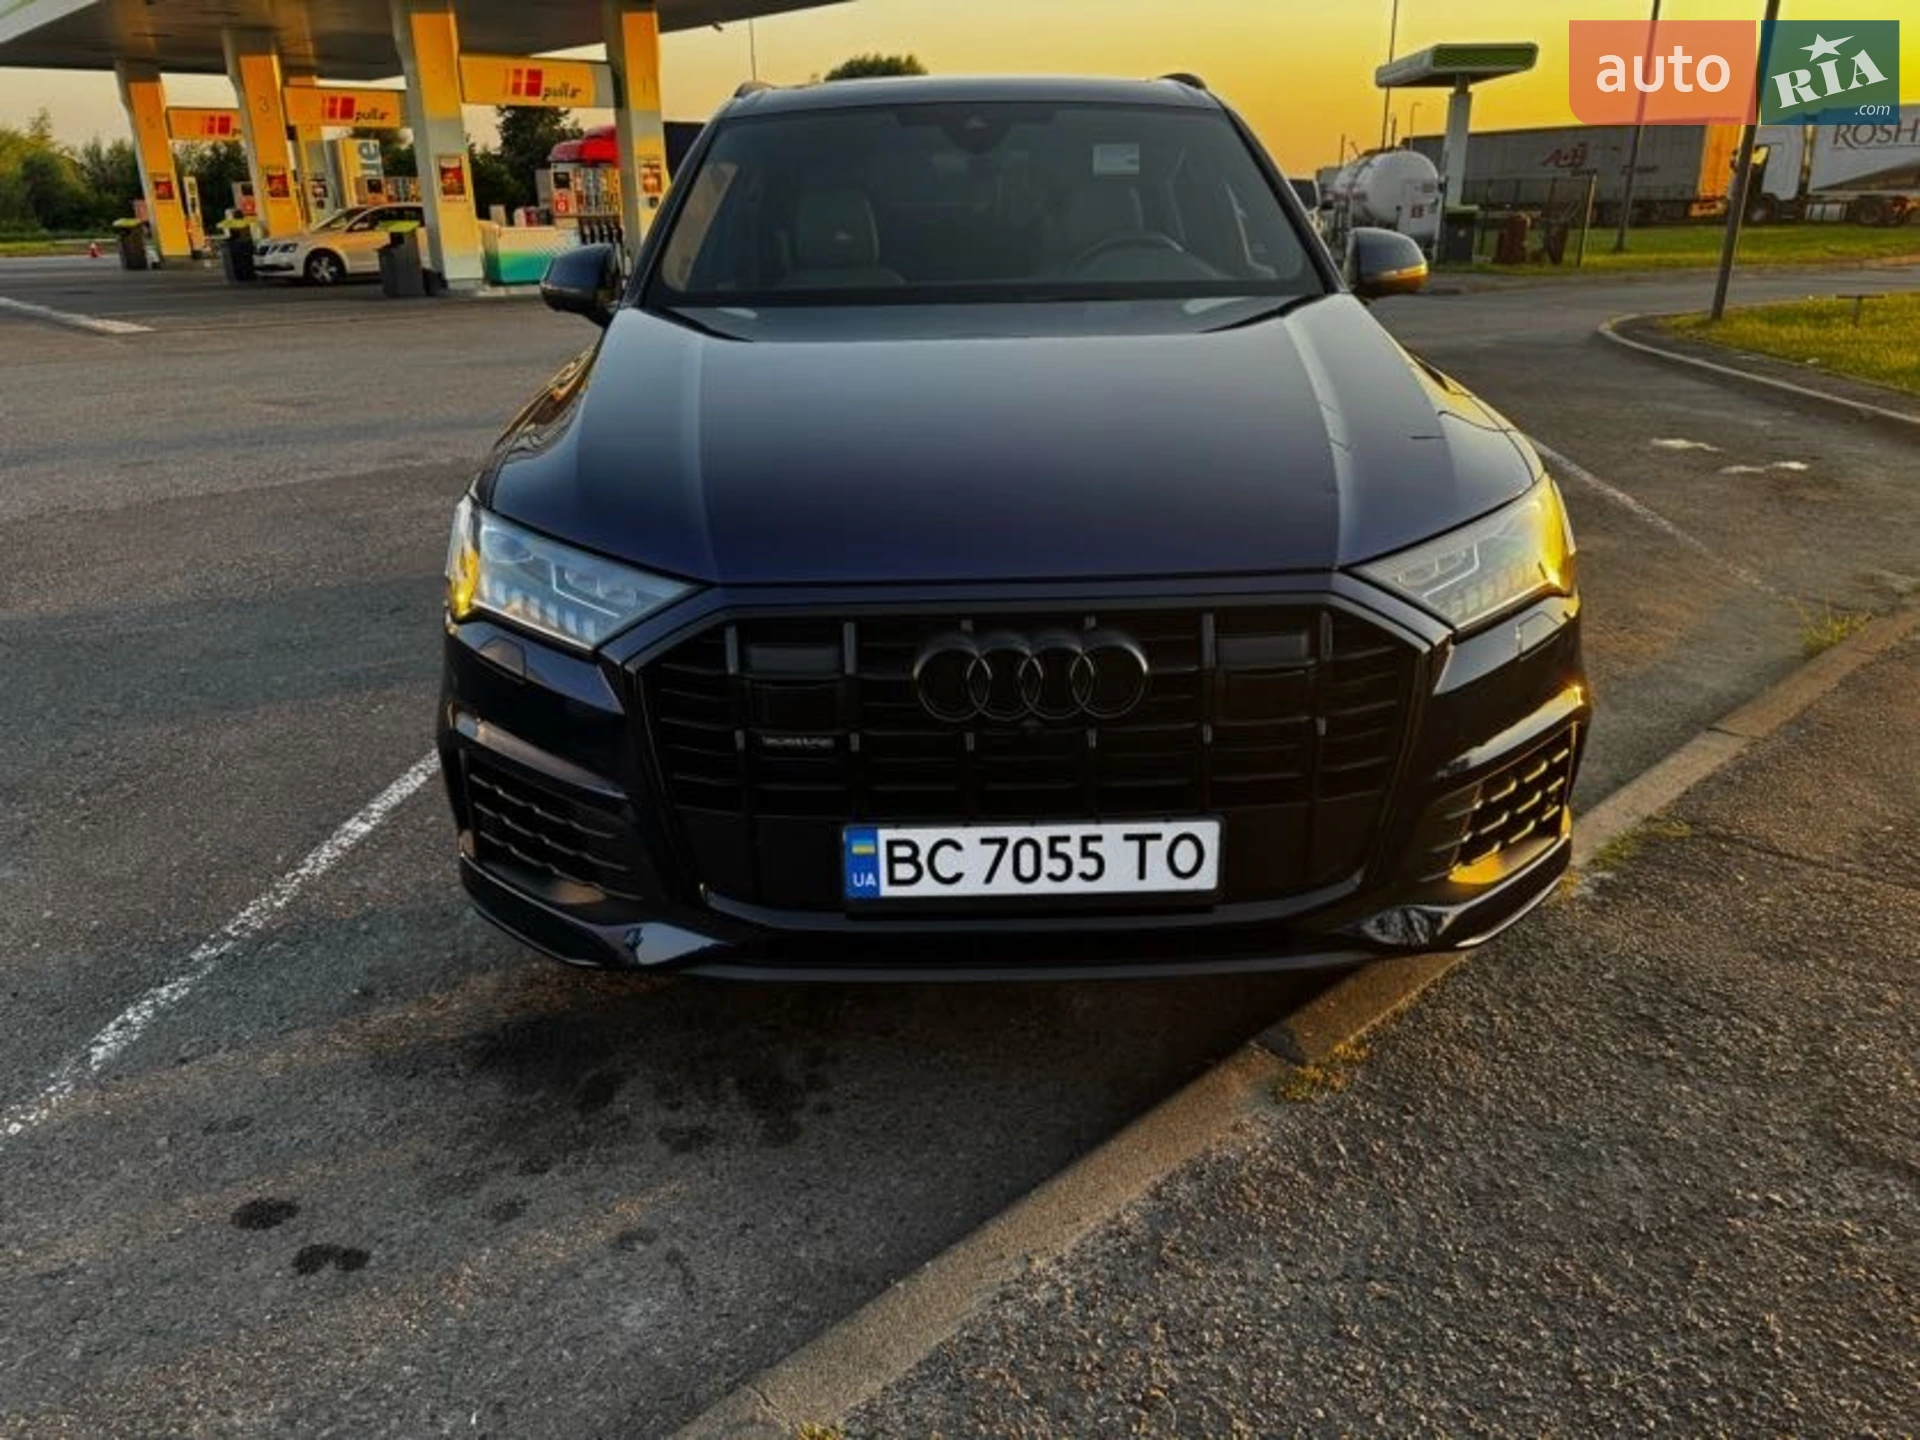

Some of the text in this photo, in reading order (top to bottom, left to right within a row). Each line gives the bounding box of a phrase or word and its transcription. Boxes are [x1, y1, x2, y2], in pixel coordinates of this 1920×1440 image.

[886, 832, 1205, 887] BC 7055 TO
[852, 872, 877, 887] UA
